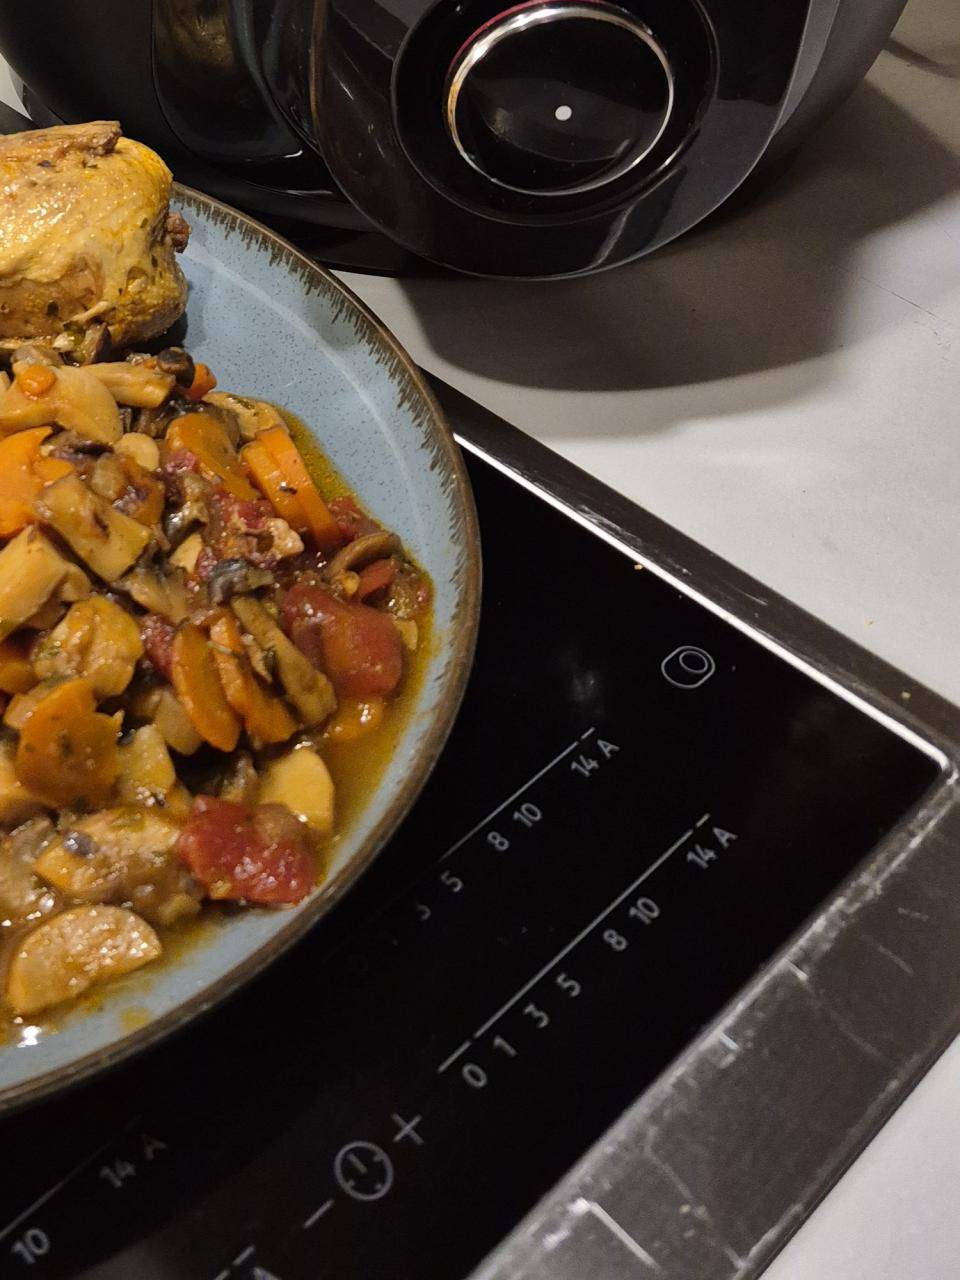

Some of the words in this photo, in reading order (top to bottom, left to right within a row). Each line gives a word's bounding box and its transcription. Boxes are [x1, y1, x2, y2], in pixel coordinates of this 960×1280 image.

[440, 871, 464, 893] 5
[487, 831, 510, 851] 8
[513, 802, 542, 827] 10
[570, 754, 600, 777] 14
[597, 738, 620, 758] A
[461, 1062, 488, 1089] 0
[493, 1035, 518, 1057] 1
[523, 1003, 550, 1028] 3
[556, 973, 582, 998] 5
[603, 929, 628, 952] 8
[629, 896, 661, 925] 10
[686, 844, 718, 869] 14
[712, 826, 738, 848] A
[11, 1227, 50, 1264] 10
